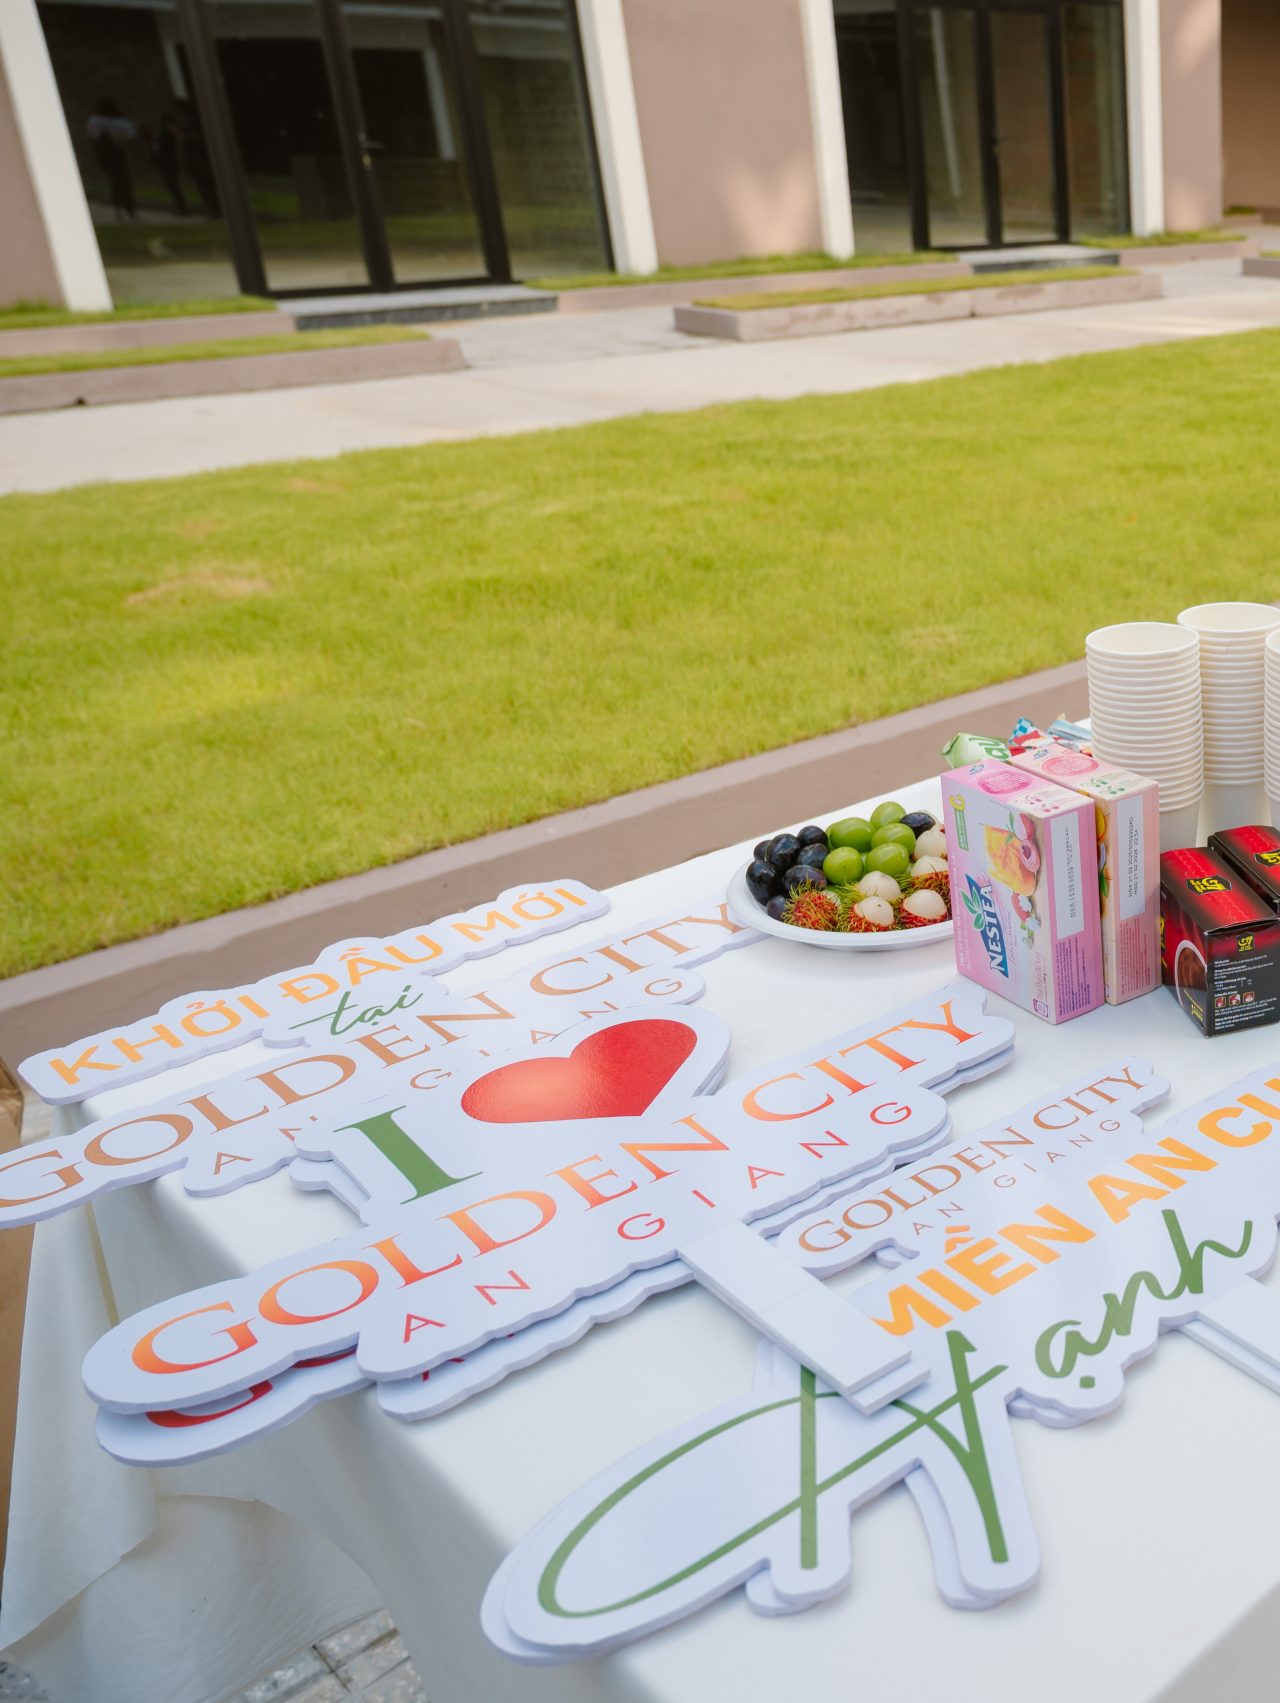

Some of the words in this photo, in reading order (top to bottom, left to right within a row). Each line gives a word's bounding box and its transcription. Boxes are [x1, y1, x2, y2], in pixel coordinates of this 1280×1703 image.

[49, 999, 270, 1085] KHỞI
[279, 933, 445, 1006] ĐẦU
[451, 887, 588, 943] MỚI
[289, 983, 425, 1037] tại
[980, 885, 1006, 972] NESTEA
[0, 991, 517, 1208] GOLDEN
[529, 902, 753, 996] CITY
[131, 1112, 730, 1375] GOLDEN
[742, 999, 985, 1123] CITY
[333, 1104, 484, 1206] I
[403, 1269, 532, 1344] AN
[617, 1101, 913, 1241] GIANG
[798, 1126, 1036, 1254] GOLDEN
[1032, 1066, 1148, 1132] CITY
[867, 1203, 1097, 1337] MIỀN
[1086, 1136, 1219, 1225] AN
[911, 1200, 965, 1236] AN
[992, 1118, 1122, 1190] GIANG
